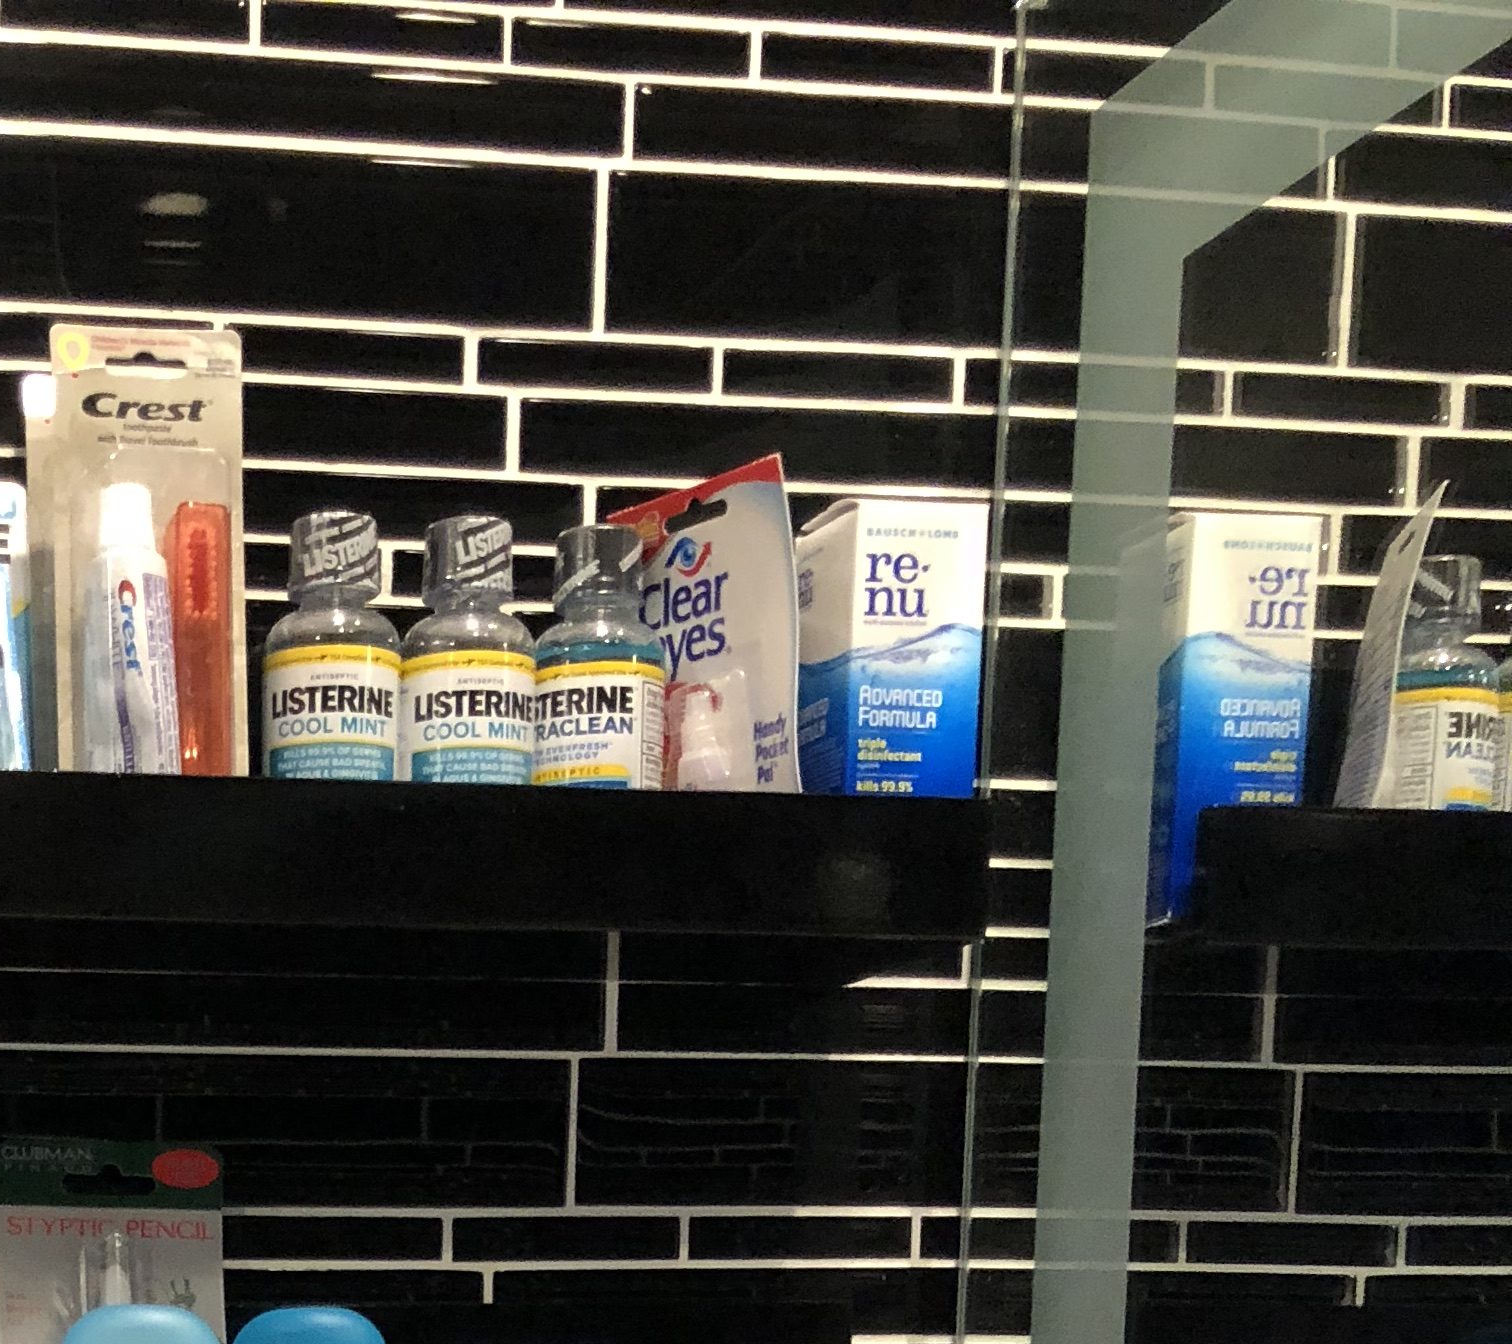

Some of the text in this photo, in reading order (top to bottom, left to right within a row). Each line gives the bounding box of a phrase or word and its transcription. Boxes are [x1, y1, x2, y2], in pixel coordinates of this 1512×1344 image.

[81, 392, 207, 422] Crest
[640, 571, 729, 630] Clear
[864, 586, 928, 618] nu
[272, 685, 393, 720] LISTERINE
[414, 690, 532, 723] LISTERINE
[859, 685, 943, 708] ADVANCED
[278, 716, 387, 738] COOL MINT
[858, 706, 937, 729] FORMULA
[423, 721, 528, 741] COOL MINT
[126, 1219, 214, 1241] PENCIL
